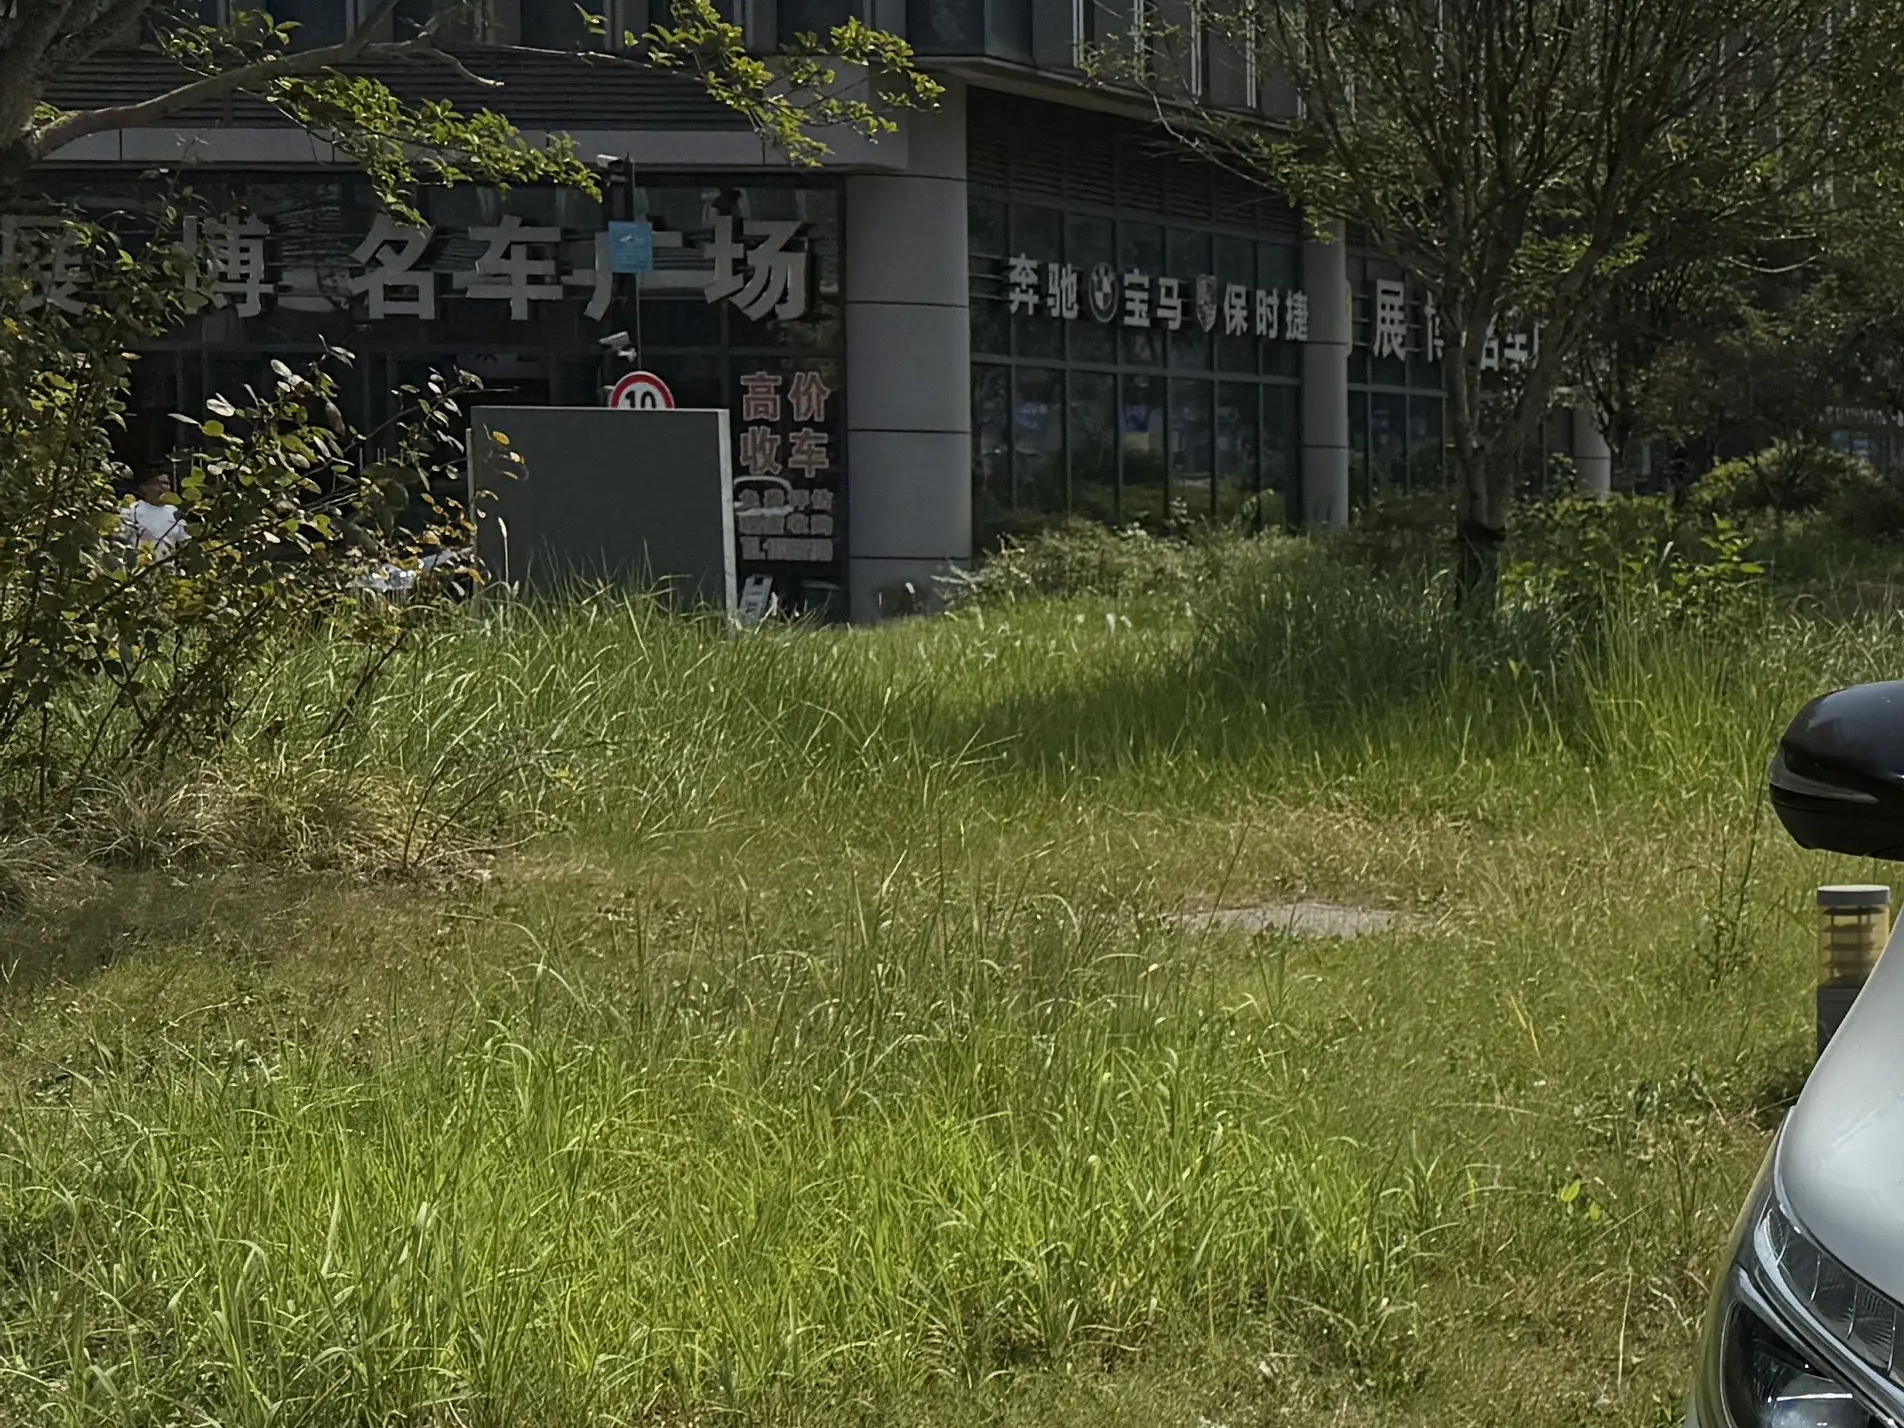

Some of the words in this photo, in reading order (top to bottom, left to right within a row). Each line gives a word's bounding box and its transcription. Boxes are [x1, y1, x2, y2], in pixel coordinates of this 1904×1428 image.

[1008, 252, 1079, 320] 奔驰
[1122, 268, 1183, 331] 宝马
[1223, 283, 1309, 342] 保时捷
[740, 371, 831, 422] 高价
[739, 425, 830, 478] 收车
